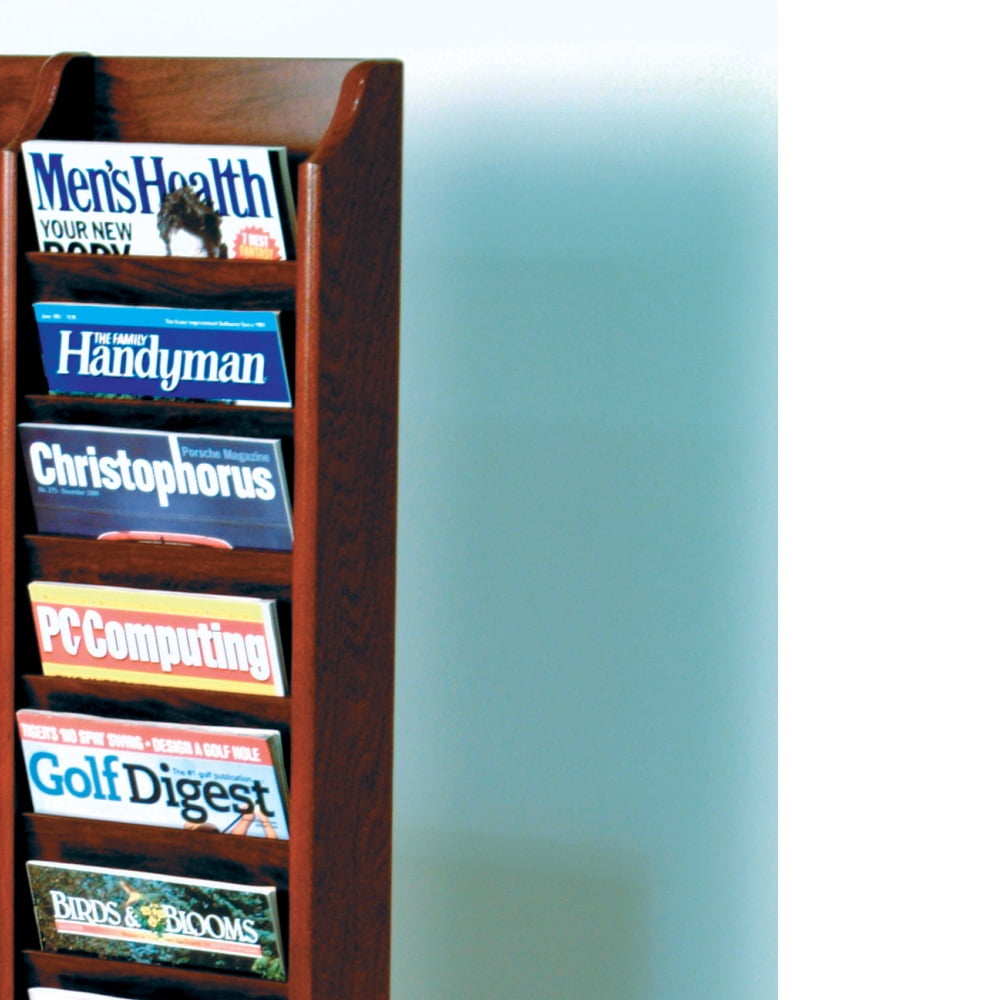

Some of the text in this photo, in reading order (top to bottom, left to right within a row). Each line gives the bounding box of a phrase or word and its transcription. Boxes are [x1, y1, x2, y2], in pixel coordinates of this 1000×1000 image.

[28, 152, 136, 214] Men's
[40, 219, 132, 241] YOUR NEW
[56, 329, 266, 392] Handyman
[94, 332, 149, 346] THE FAMILY
[29, 441, 276, 507] Christophorus
[181, 446, 270, 463] Porsche Magazine
[151, 737, 193, 756] DESIGN
[194, 741, 204, 756] A
[203, 743, 231, 759] GOLF
[231, 746, 262, 762] HOLE
[29, 751, 276, 824] Golf Digest
[49, 890, 122, 927] BIRDS
[124, 905, 142, 929] &
[162, 904, 260, 944] BLOOMS
